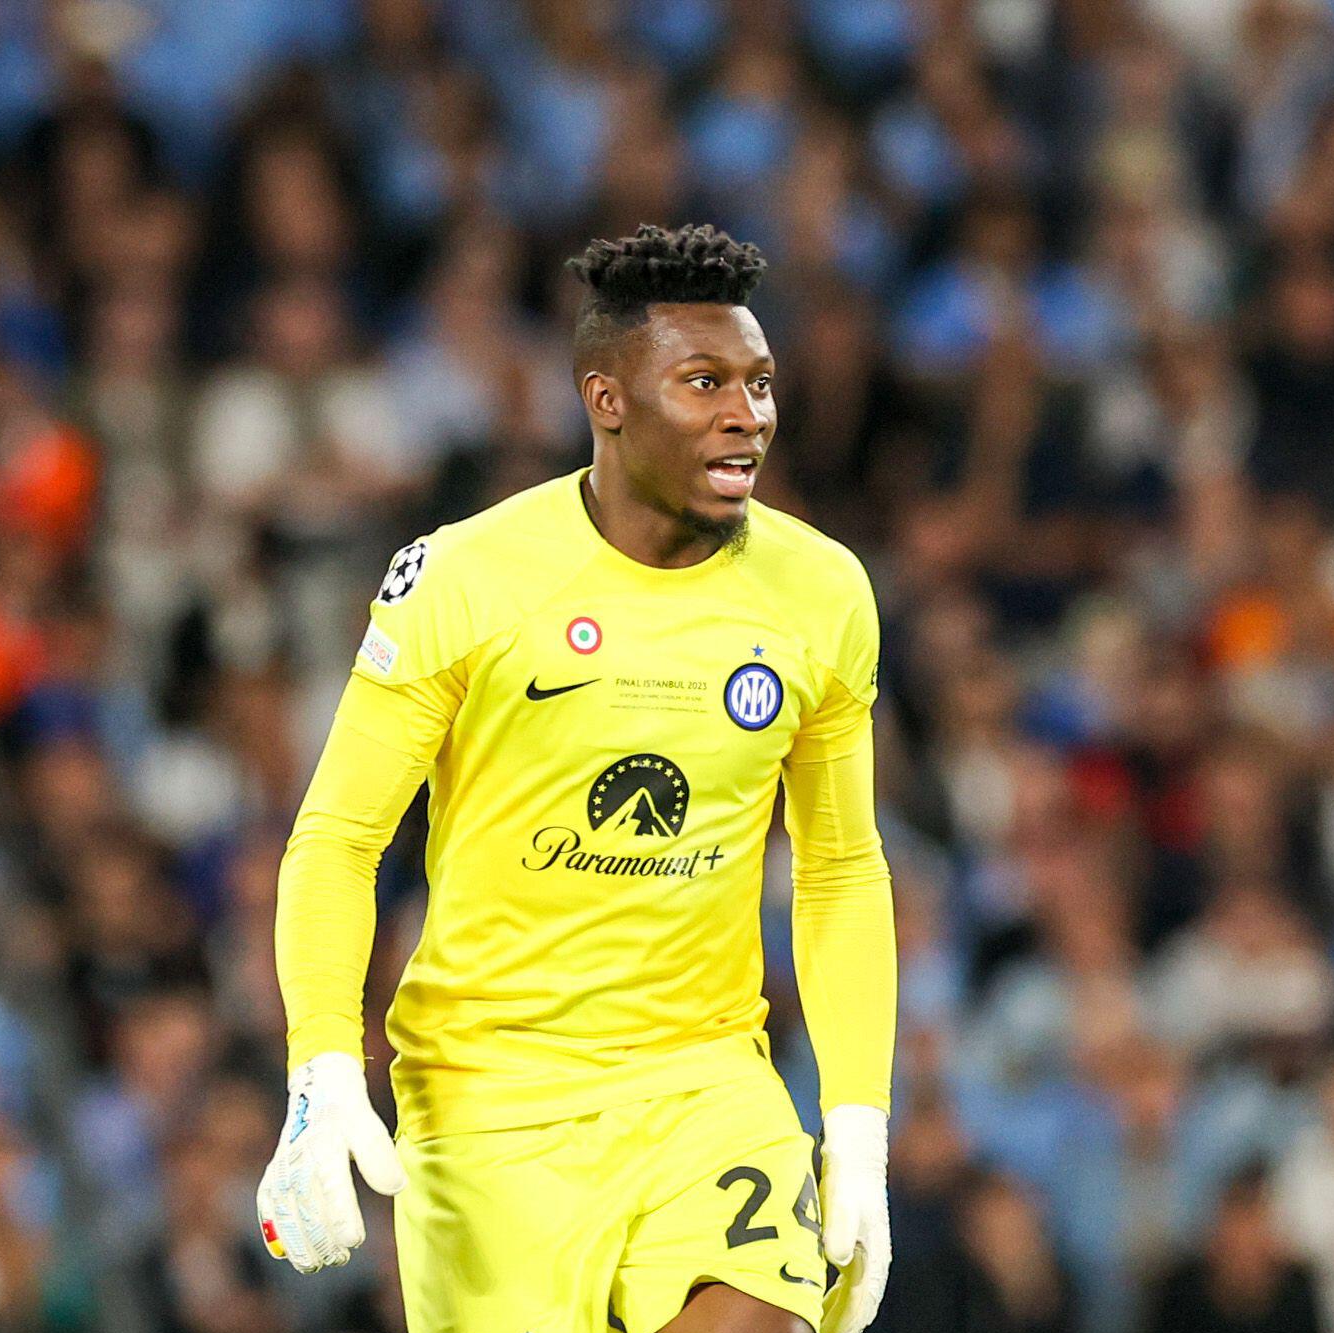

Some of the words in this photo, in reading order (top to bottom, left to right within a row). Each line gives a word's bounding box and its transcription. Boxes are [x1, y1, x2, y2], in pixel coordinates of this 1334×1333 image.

[615, 678, 641, 687] FINAL
[643, 679, 685, 689] ISTANBUL
[687, 681, 708, 691] 2023
[522, 826, 724, 878] Paramount+
